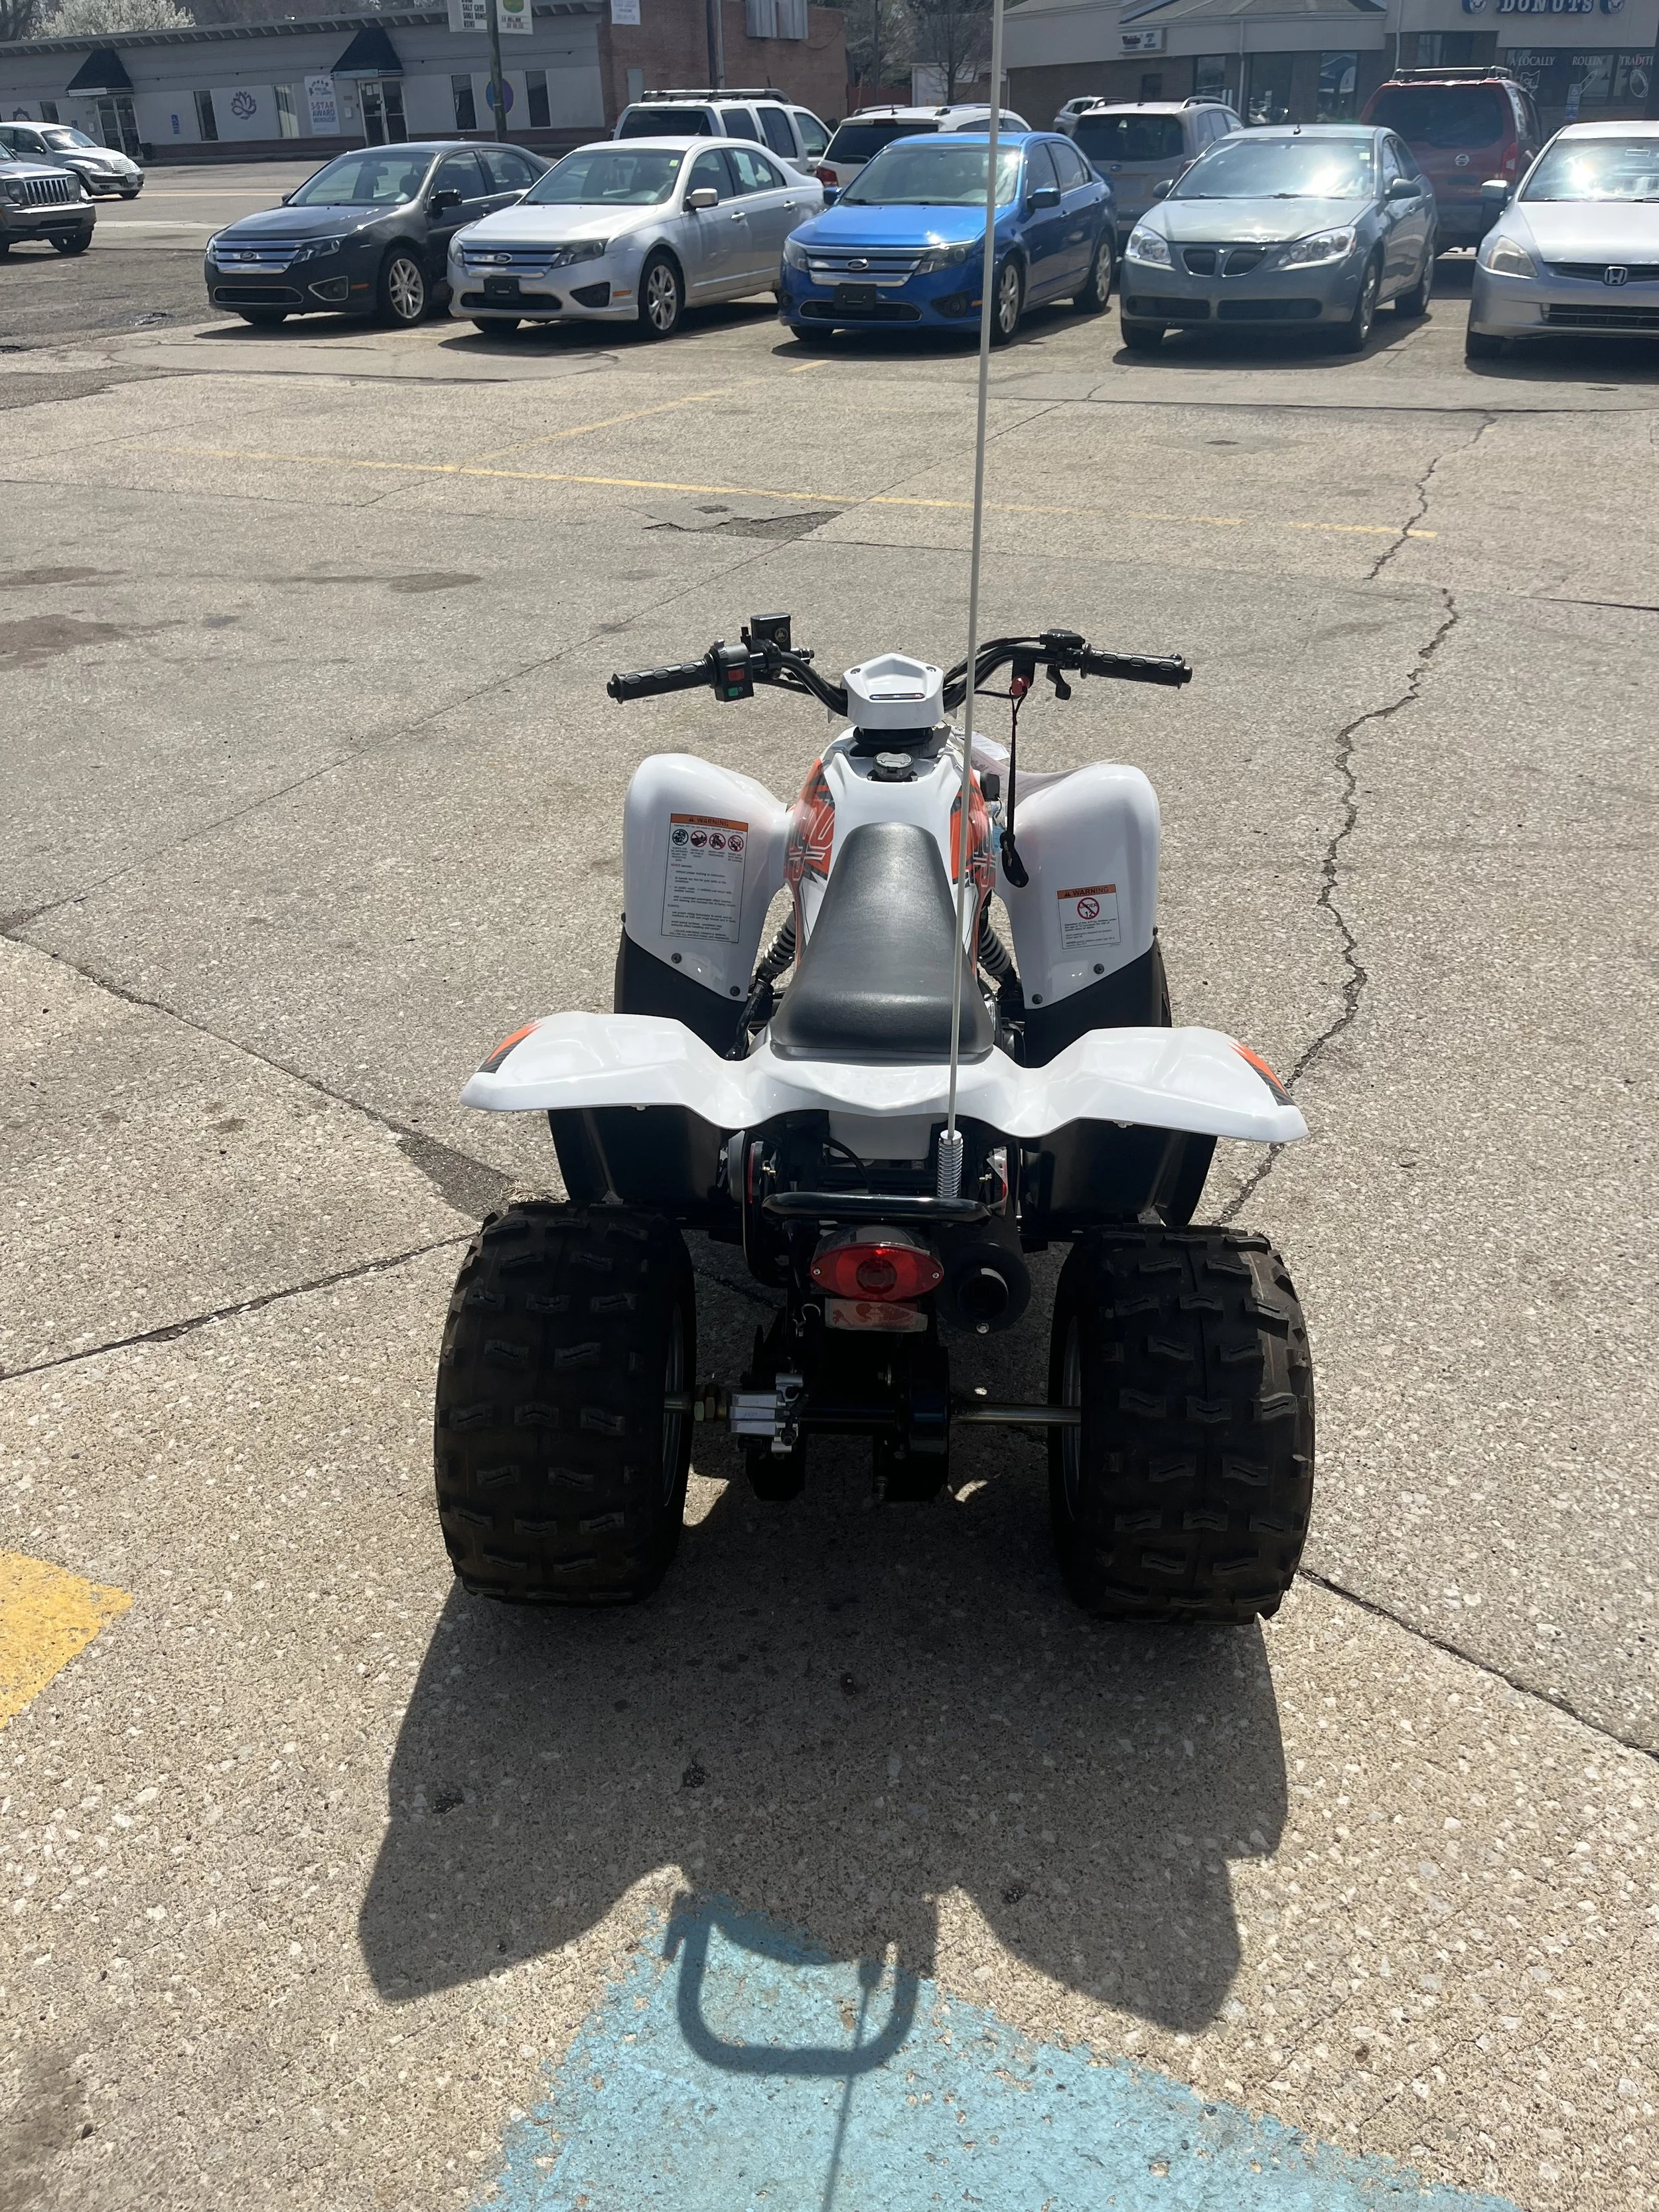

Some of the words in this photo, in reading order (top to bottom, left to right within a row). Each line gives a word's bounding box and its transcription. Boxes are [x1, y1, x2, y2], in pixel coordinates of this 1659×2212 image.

[1518, 56, 1556, 66] LOCALLY
[697, 817, 729, 827] WARNING
[1072, 887, 1109, 896] WARNING
